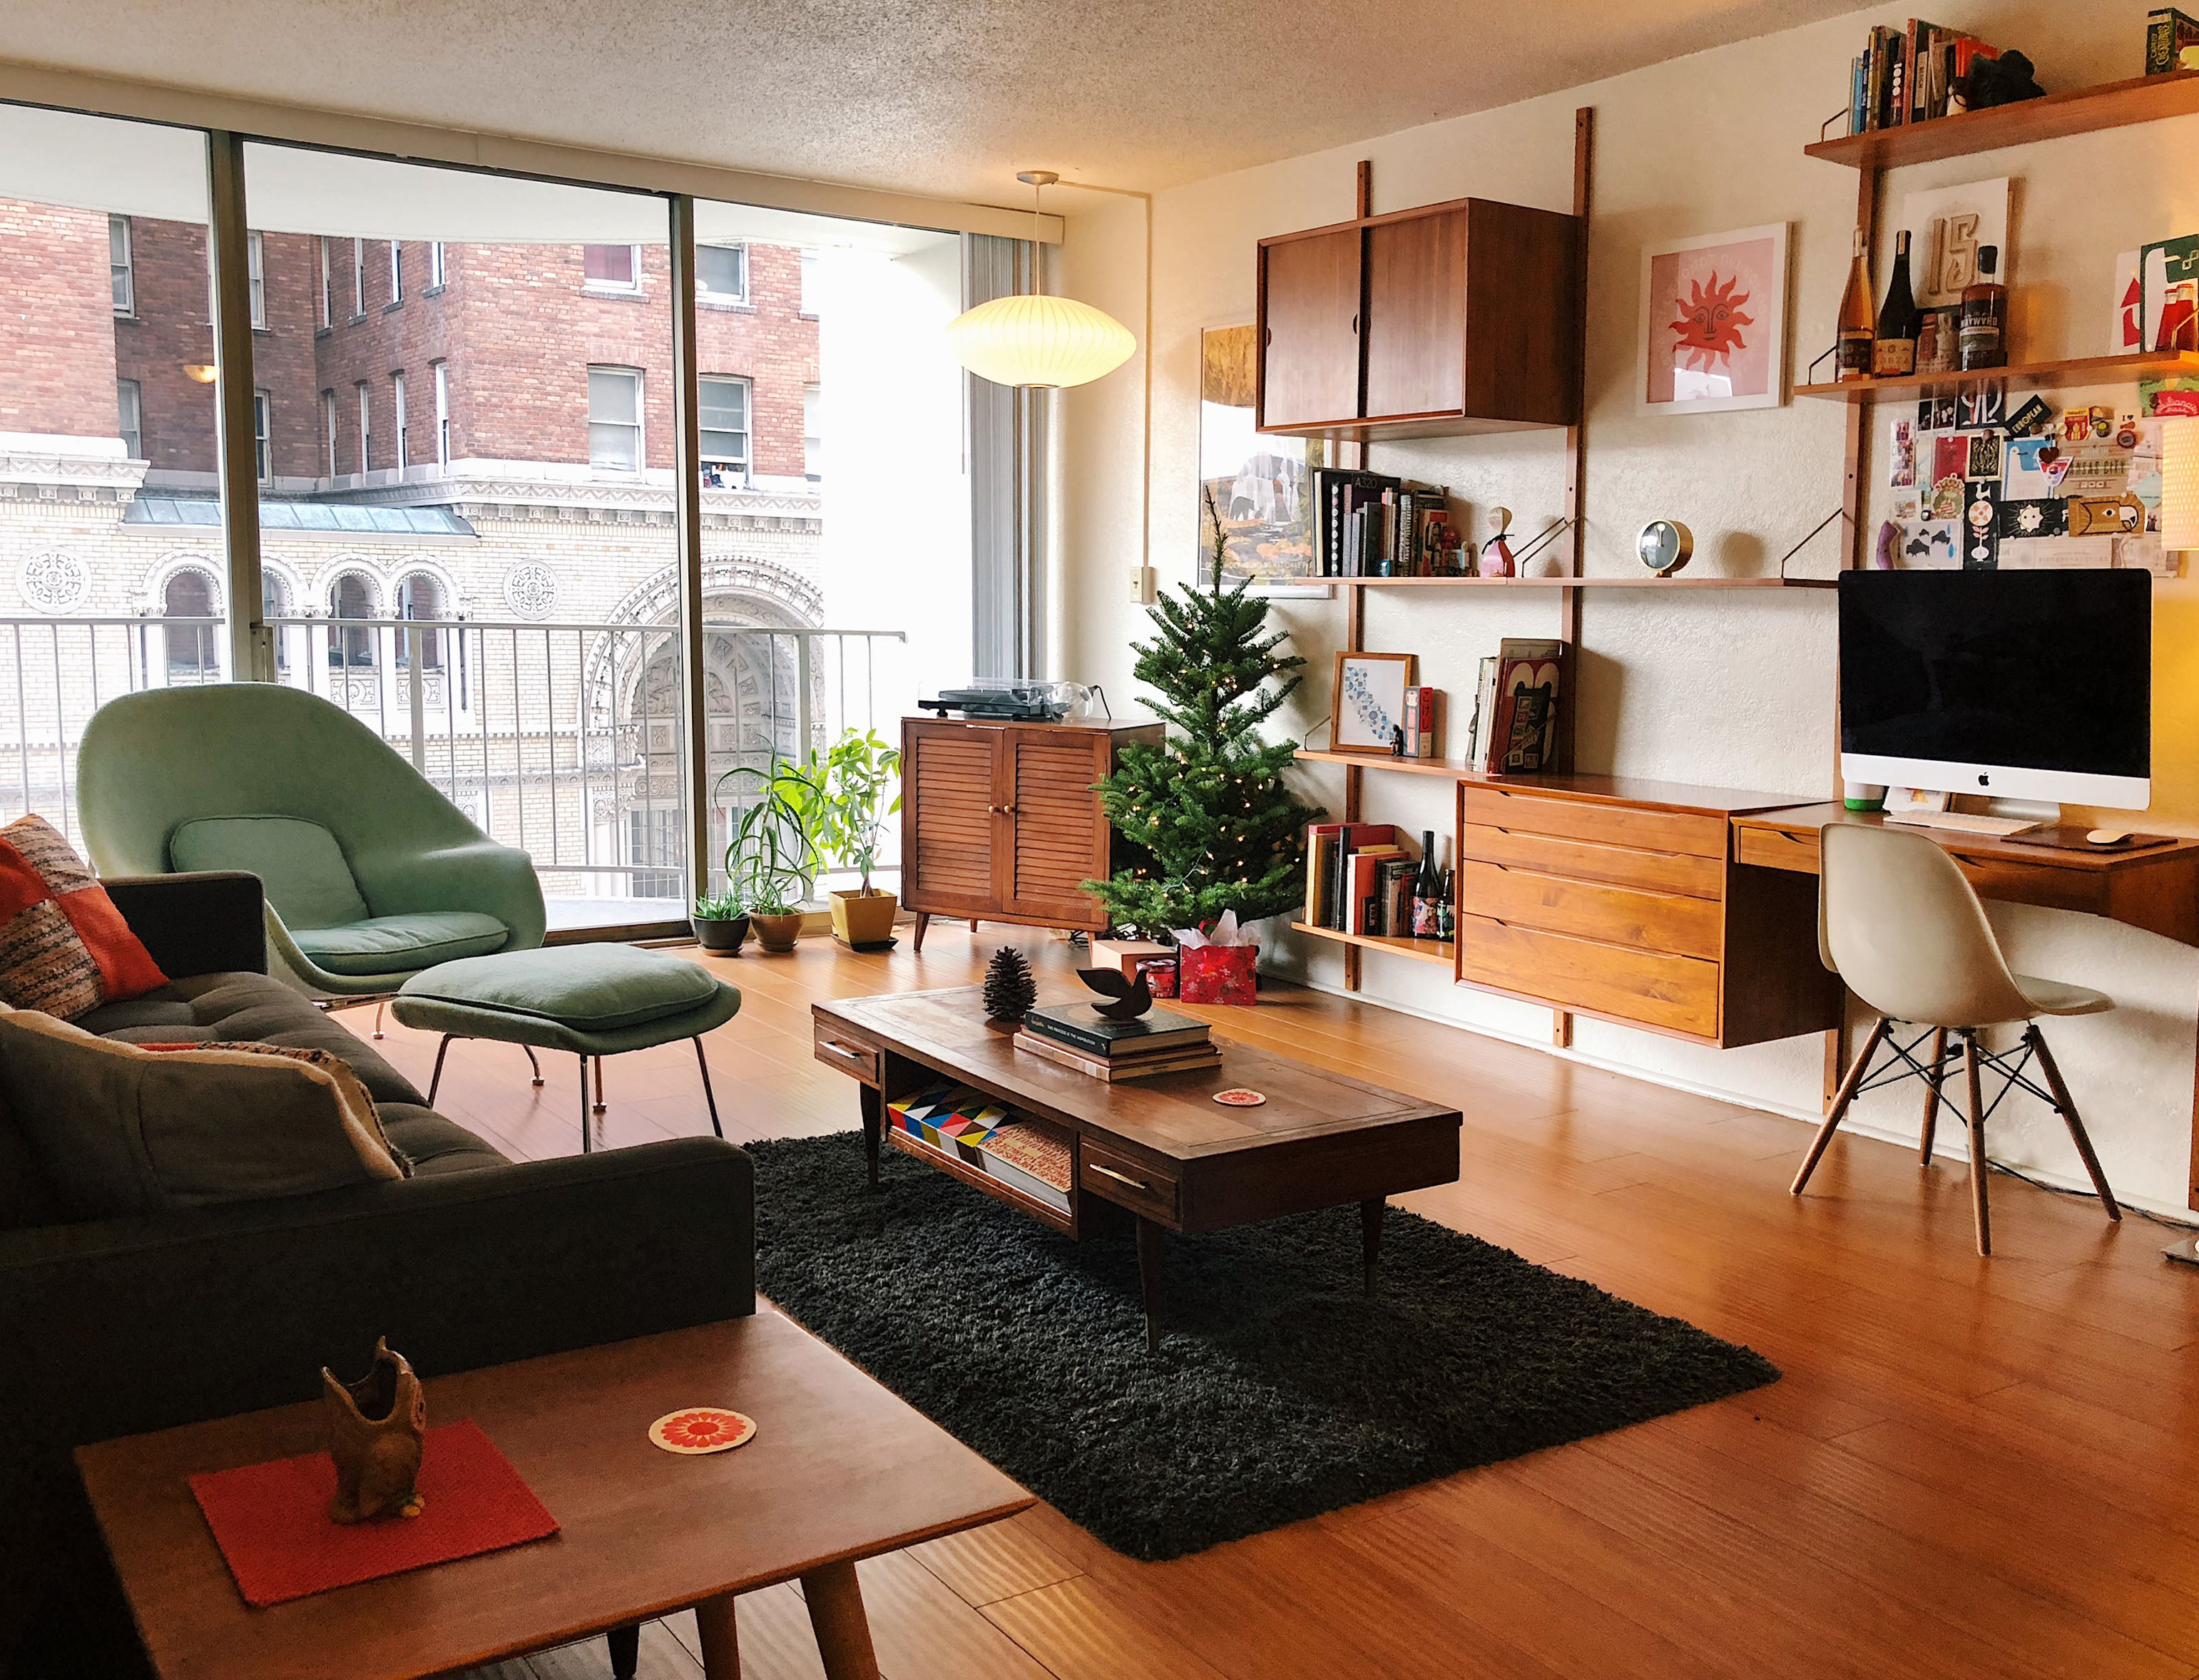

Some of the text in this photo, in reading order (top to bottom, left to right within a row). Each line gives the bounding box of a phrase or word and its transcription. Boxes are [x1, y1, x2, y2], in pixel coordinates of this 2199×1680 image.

[1927, 213, 1979, 296] 15
[2011, 404, 2043, 434] EUROPEAN
[2068, 461, 2099, 476] ANSAS
[2103, 459, 2126, 475] CITY
[1355, 477, 1378, 489] A320
[1422, 690, 1431, 730] こけし
